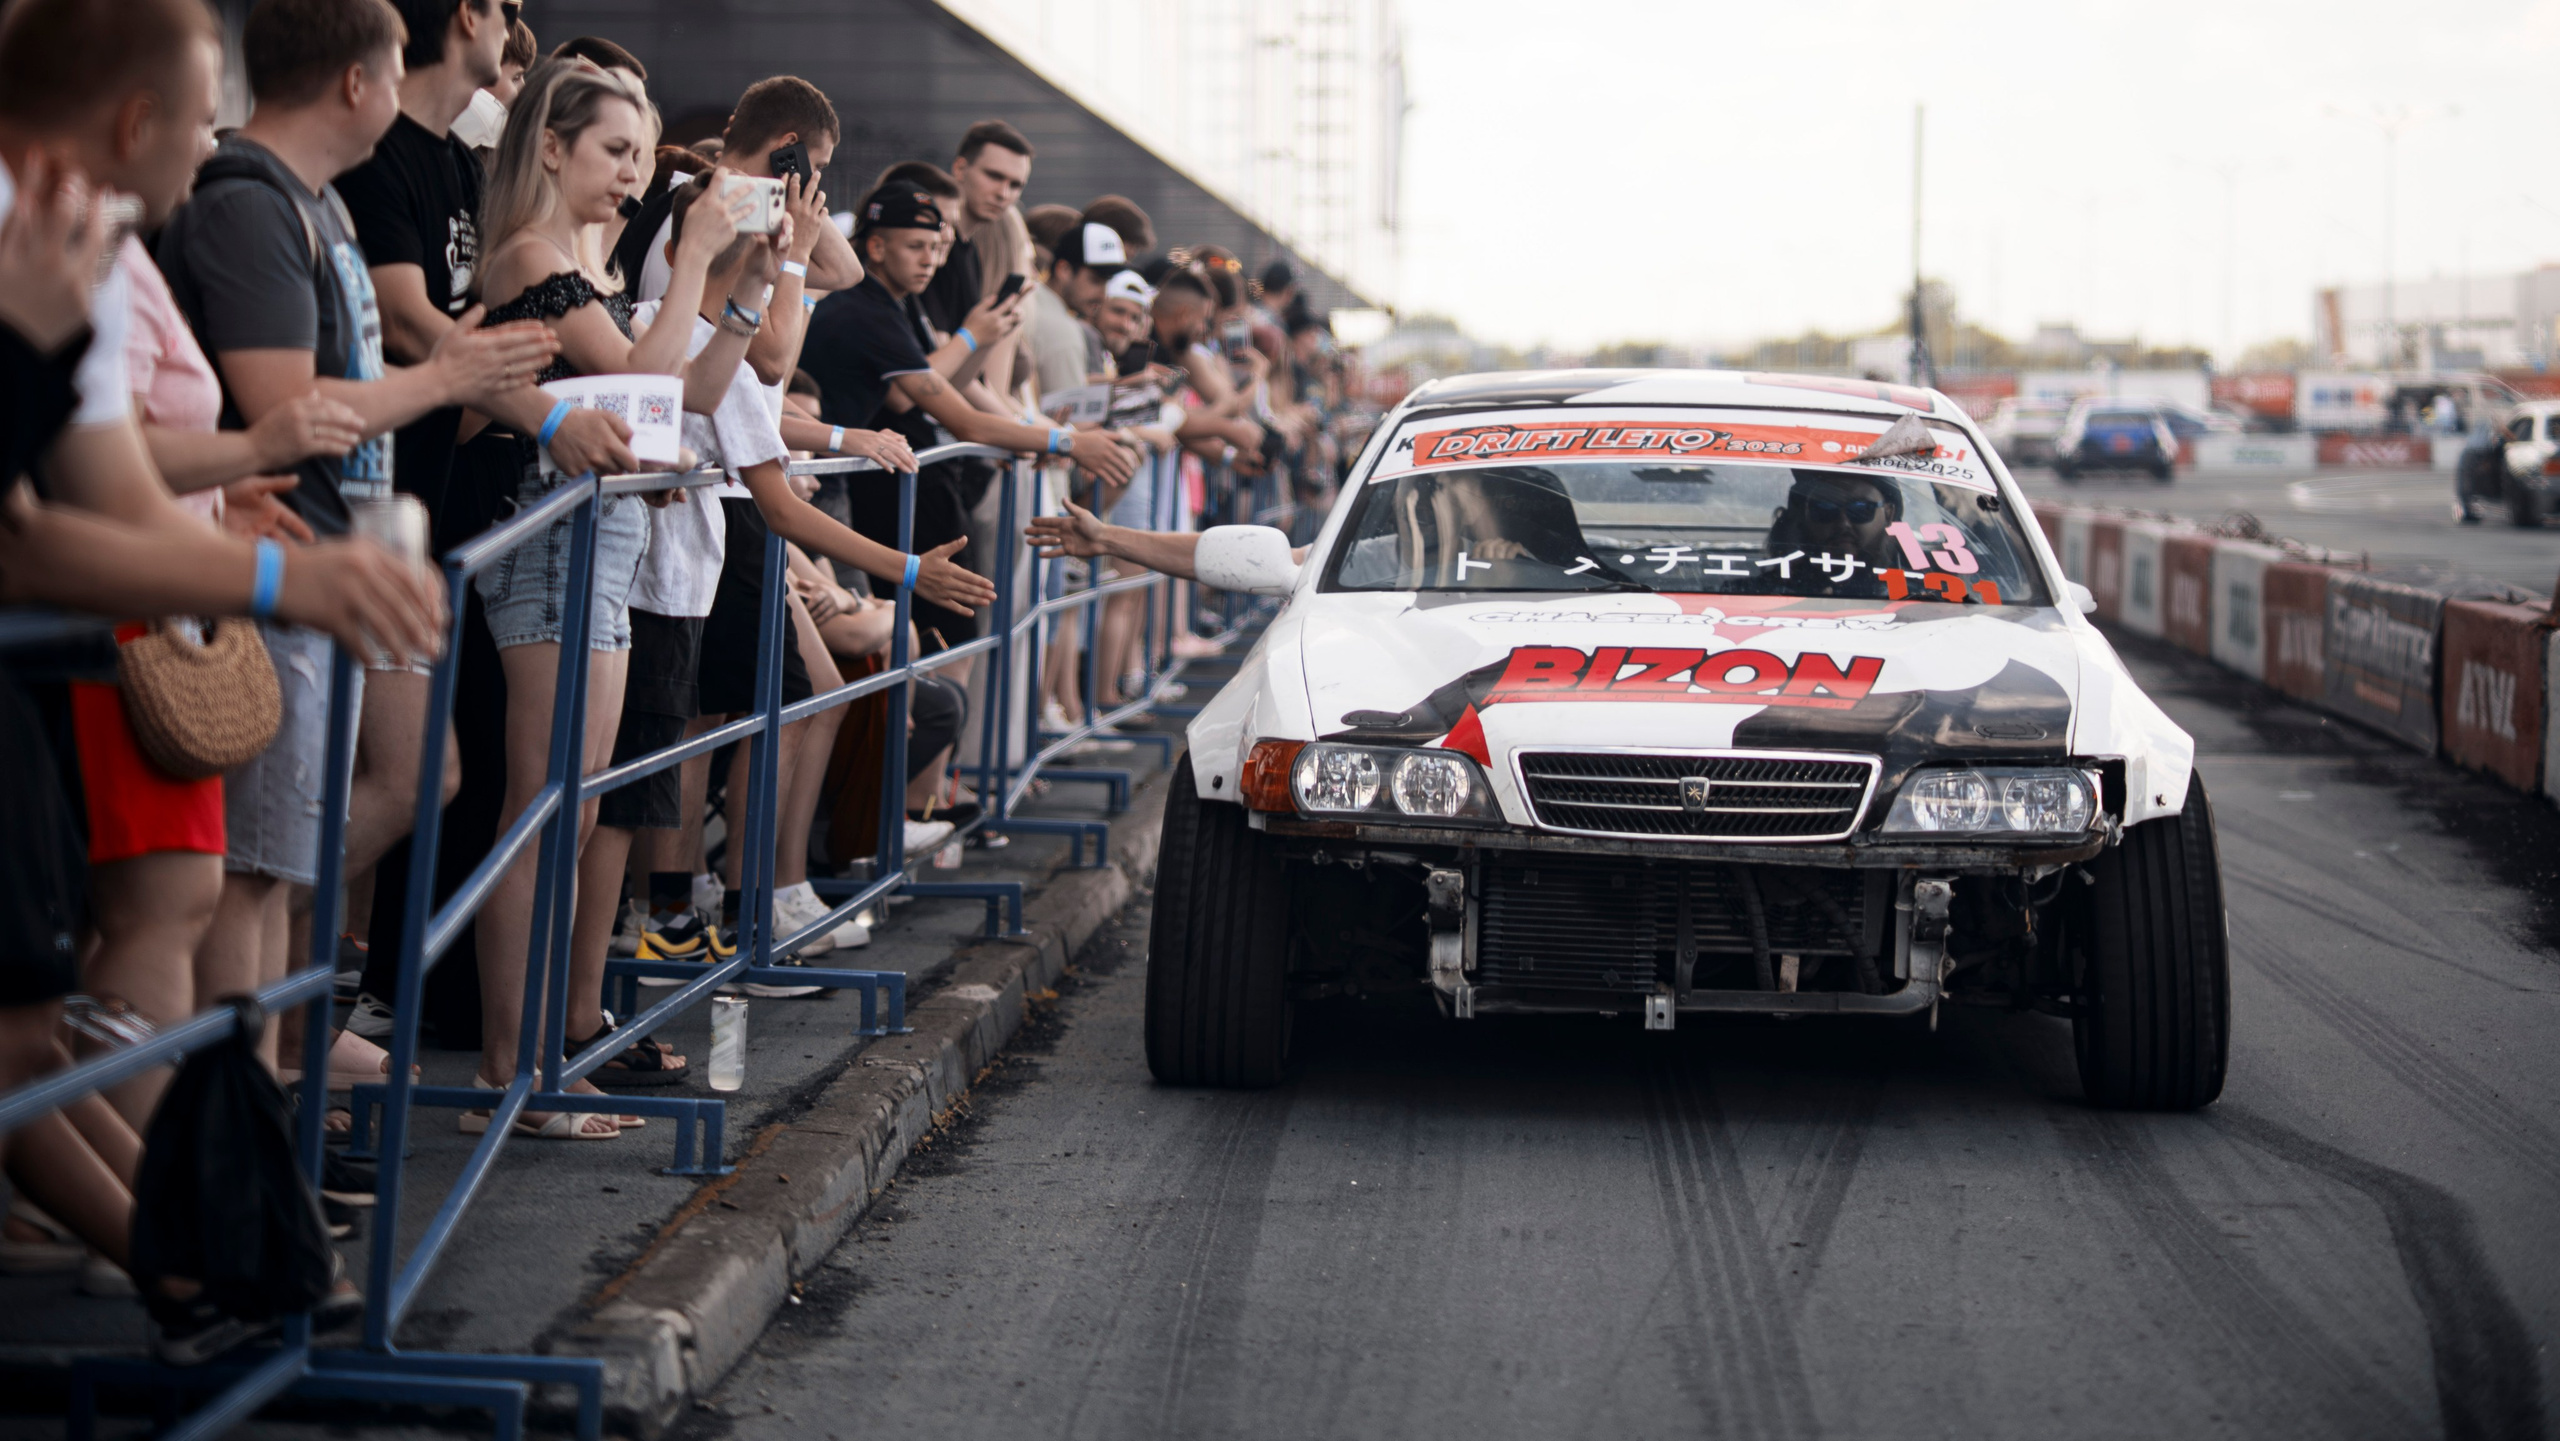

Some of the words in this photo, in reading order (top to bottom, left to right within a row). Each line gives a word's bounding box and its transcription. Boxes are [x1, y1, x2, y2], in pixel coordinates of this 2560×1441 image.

[1428, 428, 1587, 459] DRIFT
[1583, 427, 1717, 453] LETO
[1726, 439, 1804, 455] 2026
[1914, 460, 1975, 480] 2025
[1885, 521, 1979, 575] 13
[1468, 611, 1713, 625] CHASER
[1720, 615, 1911, 631] CREW
[1489, 645, 1886, 701] BIZON
